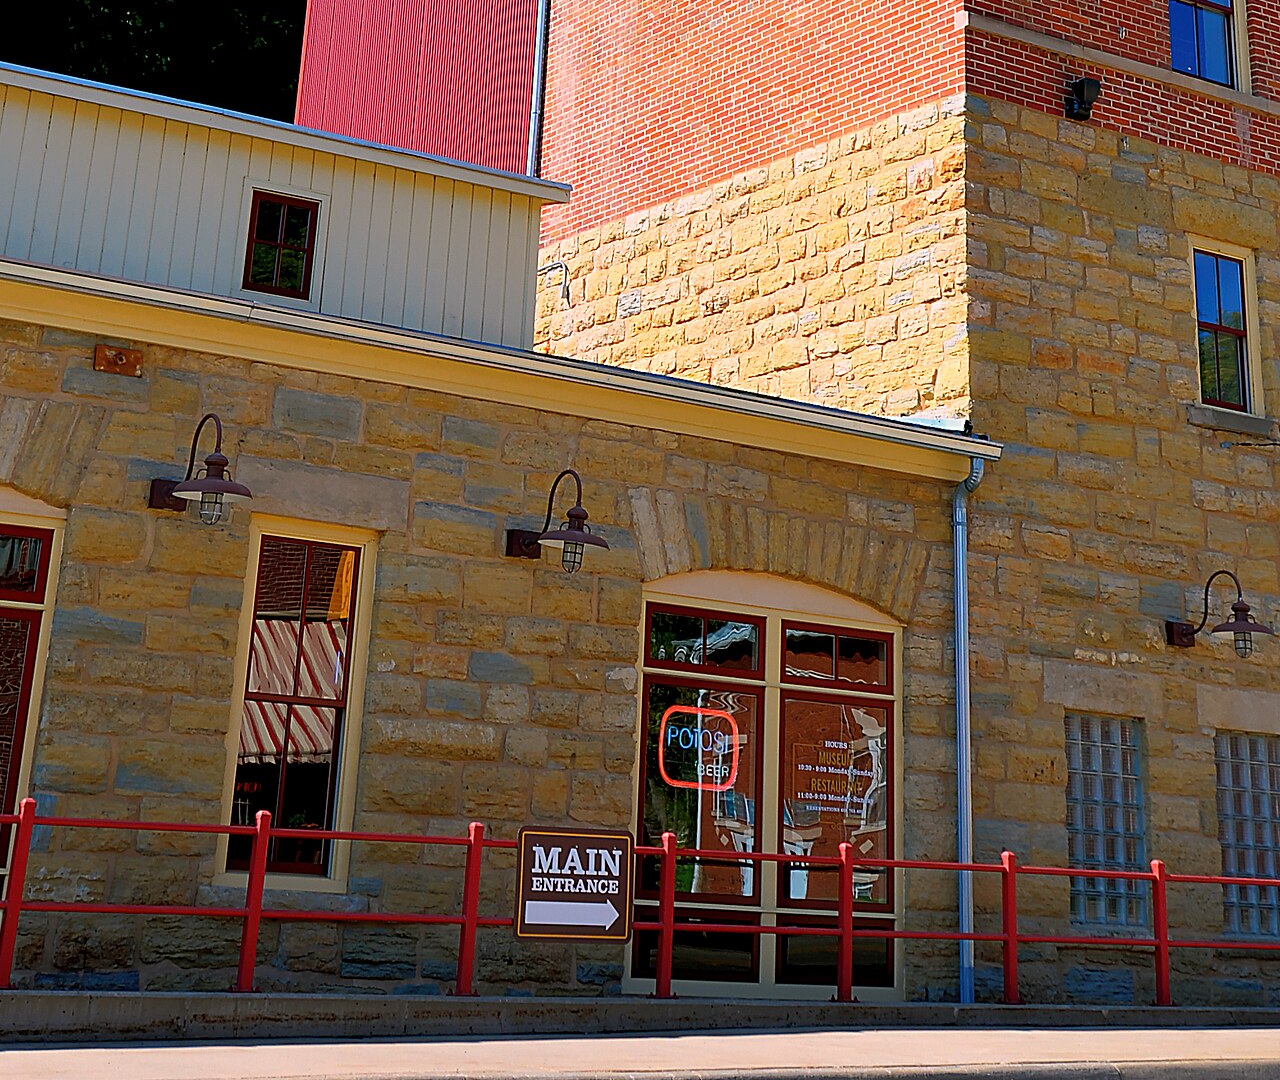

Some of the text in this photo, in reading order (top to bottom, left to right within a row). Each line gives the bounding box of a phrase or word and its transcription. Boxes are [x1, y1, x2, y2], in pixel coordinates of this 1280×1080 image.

[667, 725, 729, 755] POTOSI
[824, 740, 848, 749] HOURS
[697, 764, 730, 777] BEER
[811, 778, 863, 794] RESTAURANT
[531, 845, 623, 877] MAIN
[531, 877, 619, 895] ENTRANCE
